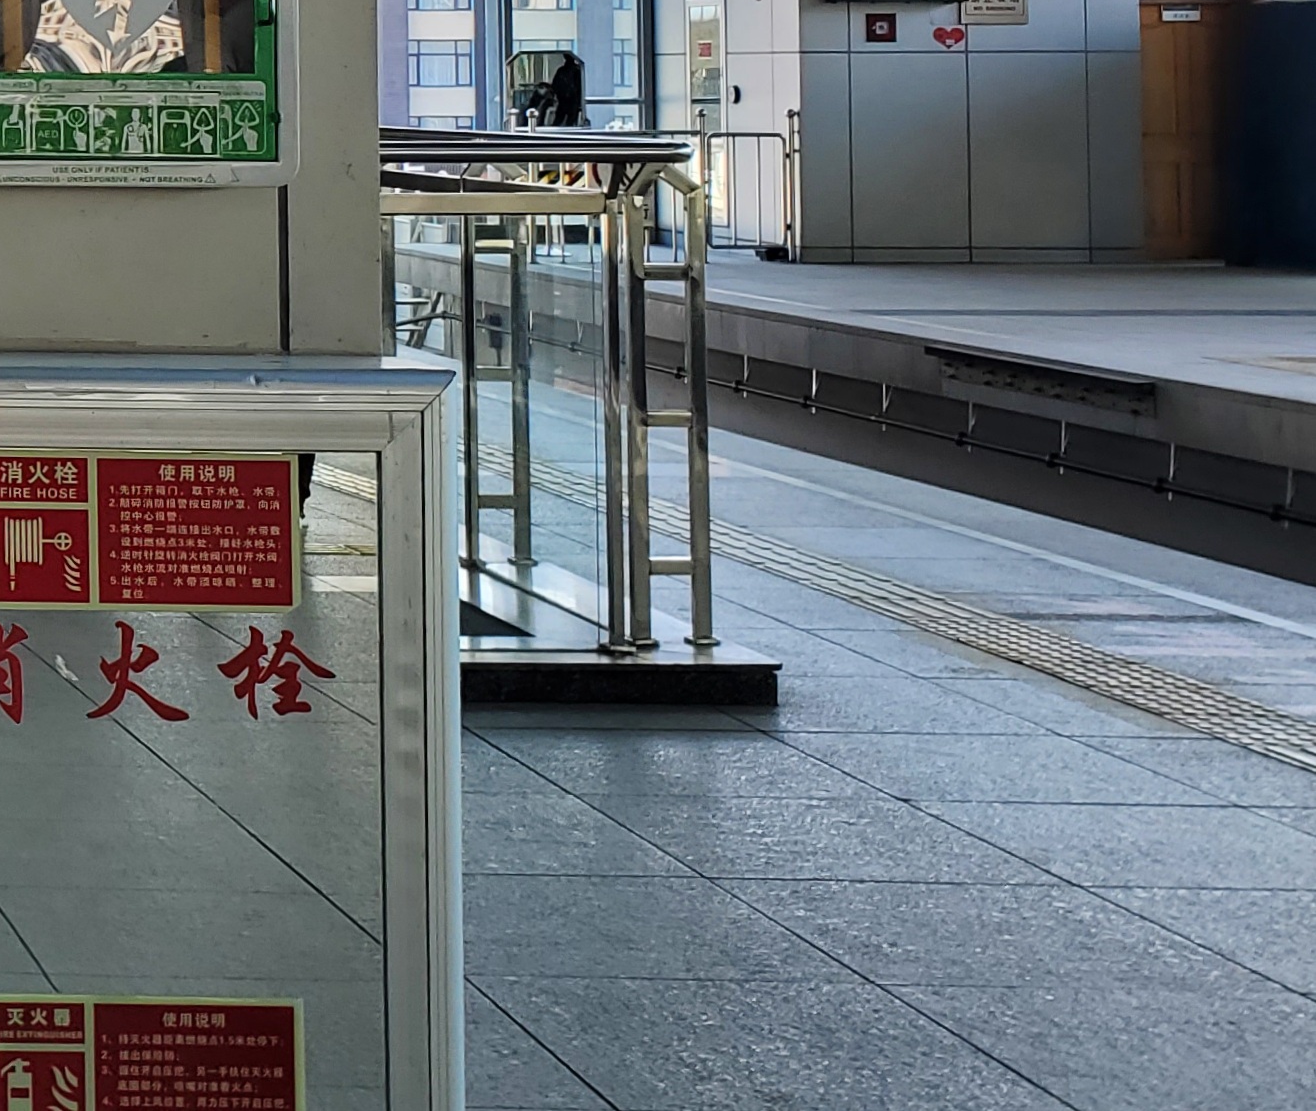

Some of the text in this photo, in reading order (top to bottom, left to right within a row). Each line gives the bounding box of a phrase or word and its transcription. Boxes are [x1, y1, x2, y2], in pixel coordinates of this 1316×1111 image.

[37, 130, 59, 139] AED
[52, 166, 69, 174] USE
[71, 166, 94, 174] ONLY
[104, 166, 141, 174] PATIENT
[157, 176, 204, 184] BREATHING
[0, 461, 79, 486] 消火栓
[158, 463, 236, 483] 使用说明
[0, 488, 78, 500] FIRE HOSE
[6, 1007, 71, 1027] 灭火器
[161, 1012, 226, 1028] 使用说明
